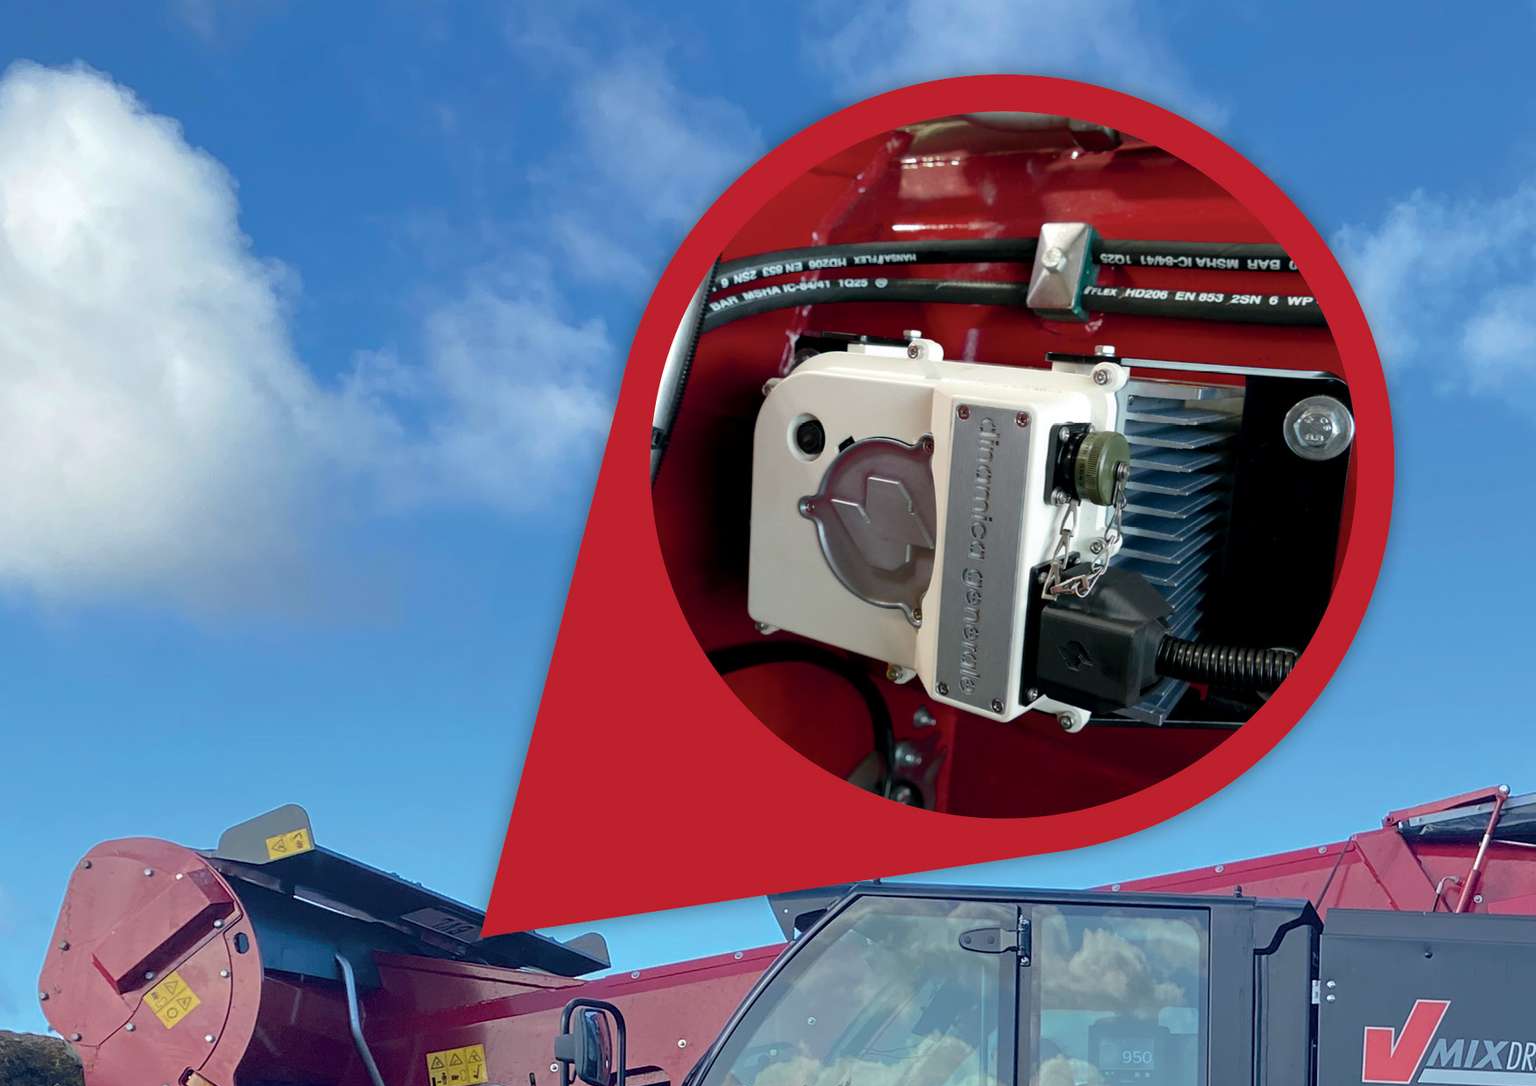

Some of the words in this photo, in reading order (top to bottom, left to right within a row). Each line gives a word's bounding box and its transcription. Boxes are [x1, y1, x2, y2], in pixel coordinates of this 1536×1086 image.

[785, 261, 803, 273] EN
[808, 258, 847, 270] HD206
[1140, 255, 1192, 268] IC-84/41
[1195, 257, 1239, 269] MSHA
[1248, 258, 1280, 270] BAR
[733, 270, 757, 285] 2SN
[709, 296, 738, 312] BAR
[742, 286, 782, 301] MSHA
[1124, 287, 1168, 300] HD206
[1174, 290, 1195, 301] EN
[1231, 294, 1262, 304] 2SN
[1269, 295, 1278, 305] 6
[1287, 296, 1314, 306] WP
[969, 416, 1000, 560] dinamica
[959, 567, 984, 695] generale
